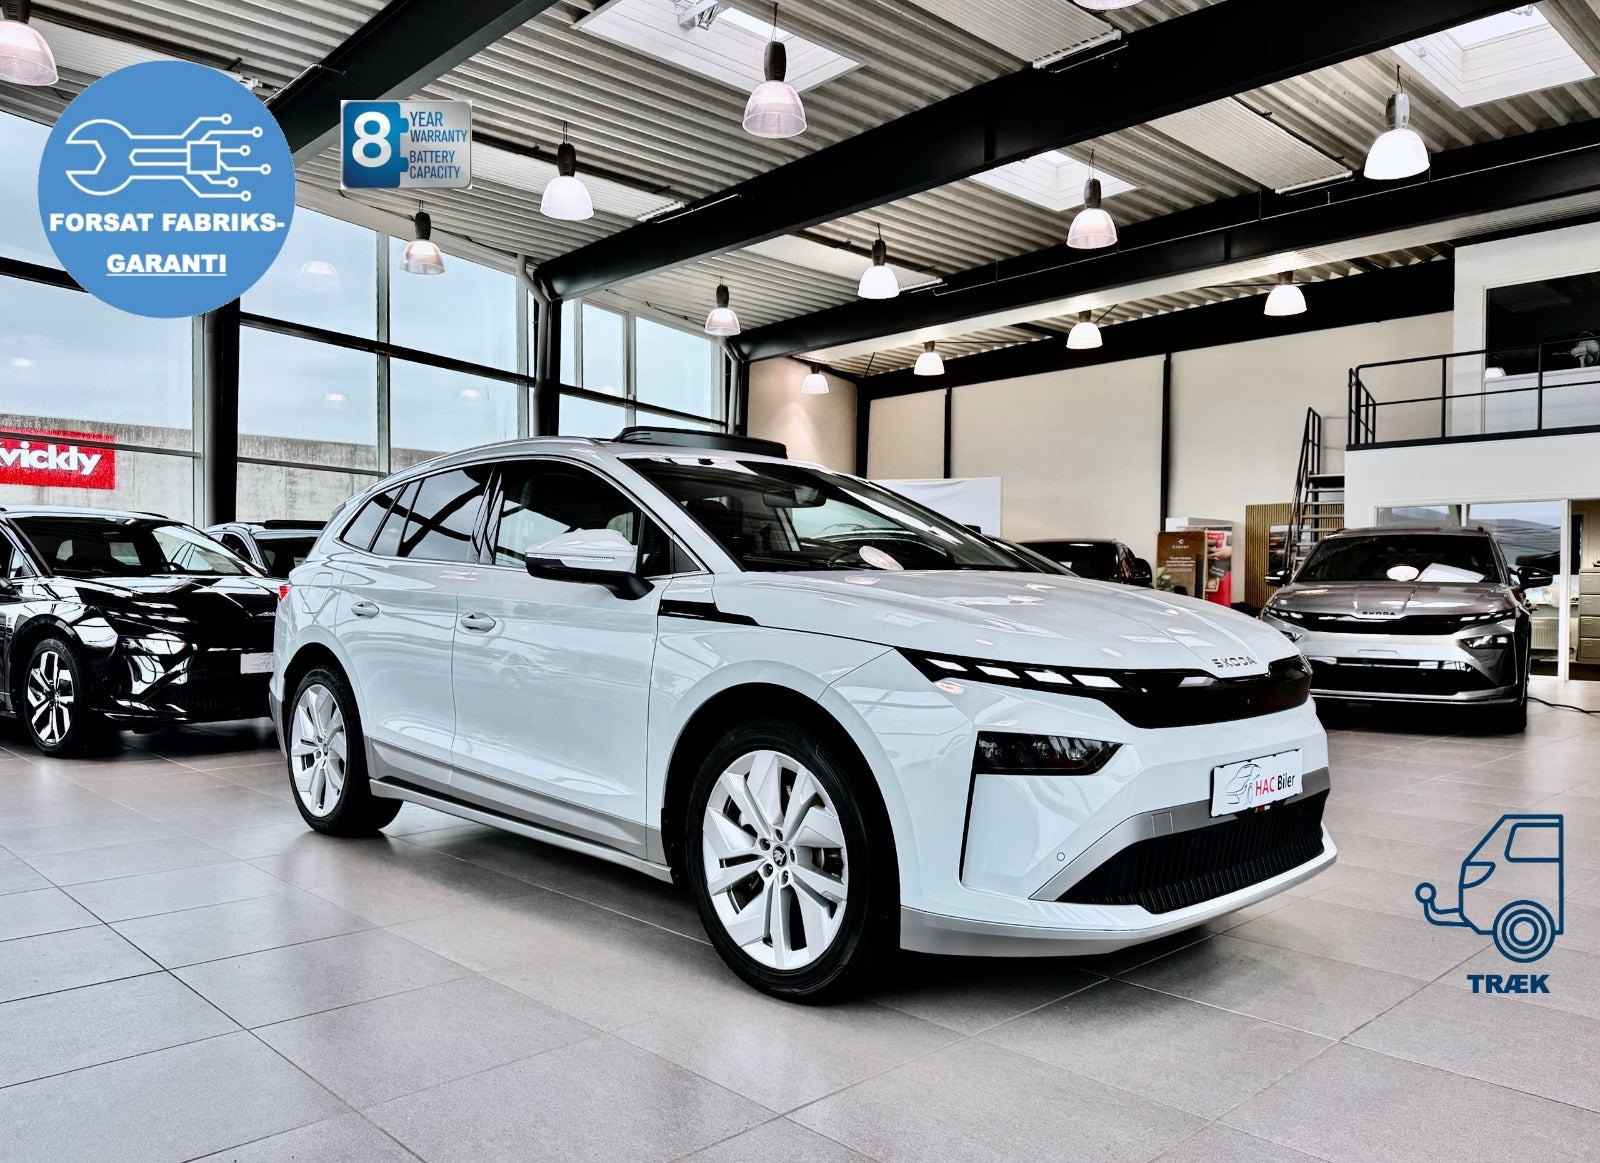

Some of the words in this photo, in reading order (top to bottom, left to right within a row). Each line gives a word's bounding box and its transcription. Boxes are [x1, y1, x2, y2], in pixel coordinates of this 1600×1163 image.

[0, 440, 102, 476] vickly
[1255, 775, 1276, 797] HAC
[1277, 772, 1296, 791] Biler
